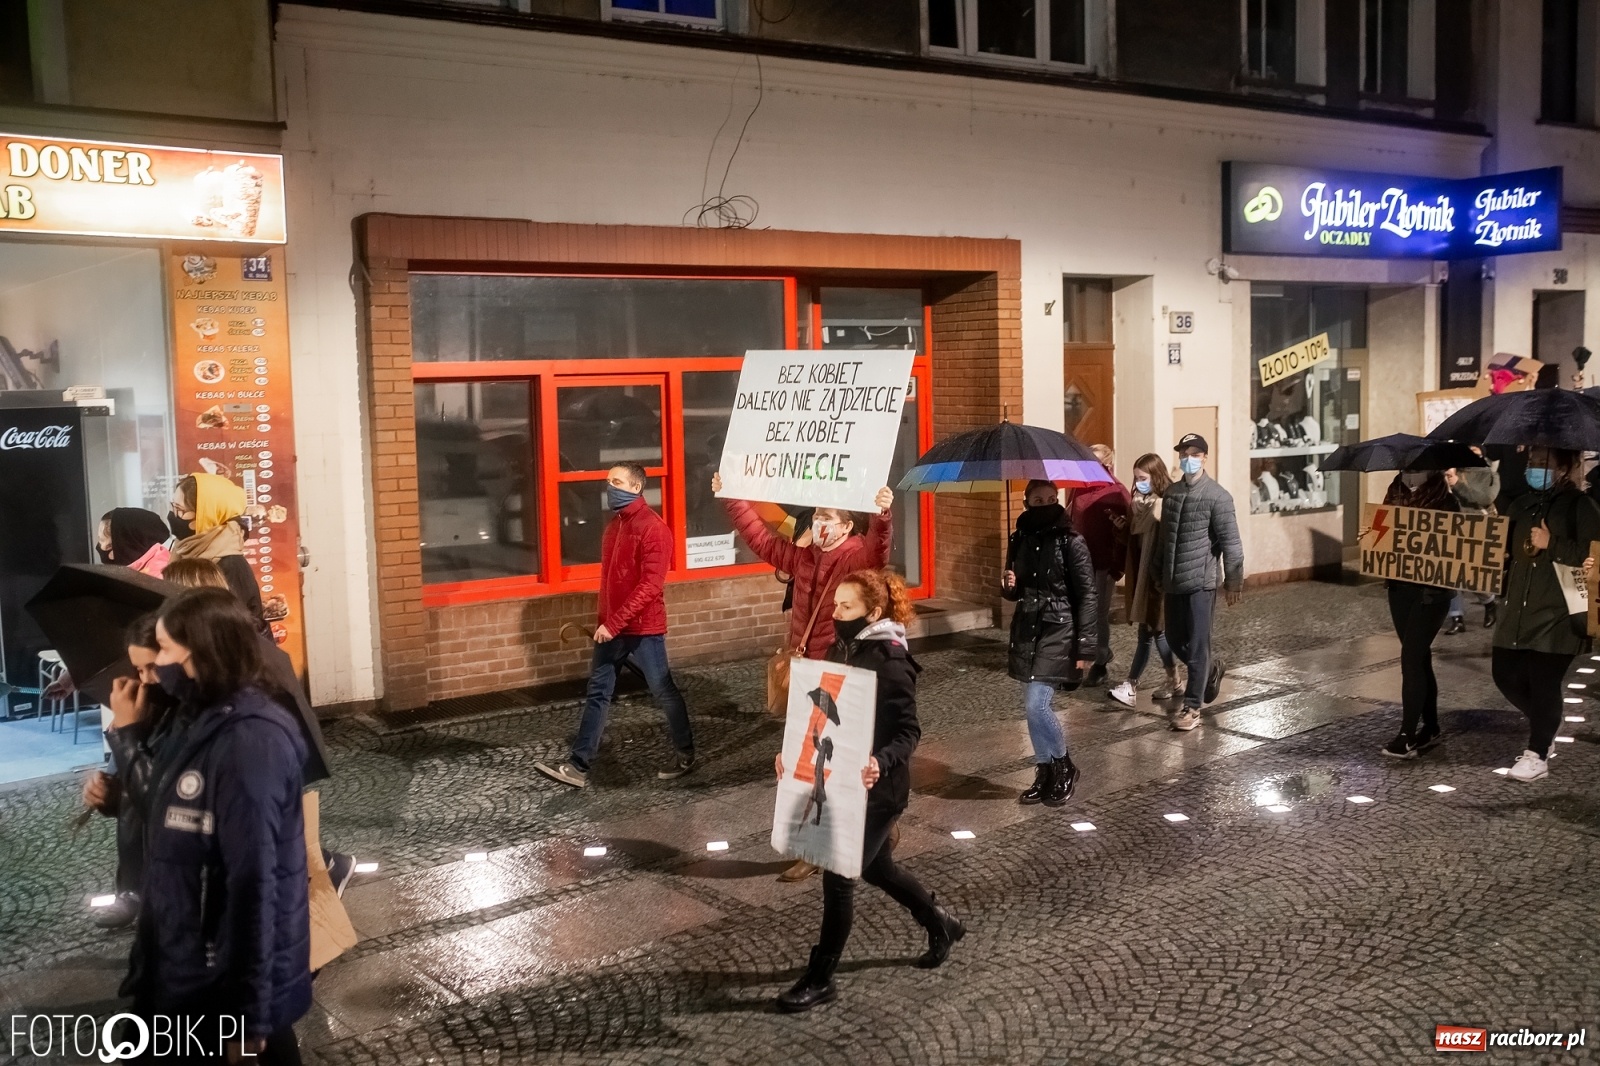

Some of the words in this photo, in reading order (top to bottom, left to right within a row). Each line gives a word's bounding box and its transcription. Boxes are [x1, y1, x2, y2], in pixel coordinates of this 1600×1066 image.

[7, 142, 155, 186] DONER
[1301, 182, 1380, 240] Jubiler
[1475, 187, 1542, 220] Jubiler
[1474, 218, 1542, 247] Złotnik
[249, 257, 267, 273] 34
[176, 289, 239, 300] NAJLEPSZY
[241, 290, 278, 302] KEBAB
[197, 305, 226, 314] KEBAB
[1176, 315, 1192, 329] 36
[197, 345, 226, 353] KEBAB
[227, 345, 260, 353] TALERZ
[778, 364, 804, 385] BEZ
[808, 361, 863, 386] KOBIET
[1262, 351, 1299, 382] ZŁOTO
[195, 391, 225, 399] KEBAB
[227, 391, 236, 399] W
[237, 390, 265, 399] BUŁCE
[736, 390, 788, 410] DALEKO
[791, 389, 815, 412] NIE
[818, 386, 902, 420] ZAJDZIECIE
[0, 425, 74, 450] Coca-Cola
[197, 442, 226, 450] KEBAB
[228, 441, 237, 450] W
[238, 439, 269, 449] CIEŚCIE
[765, 421, 794, 442] BEZ
[795, 420, 856, 444] KOBIET
[743, 452, 851, 482] WYGINIECIE
[714, 539, 730, 547] LOKAL
[1362, 549, 1502, 594] WYPIERDALAJTE
